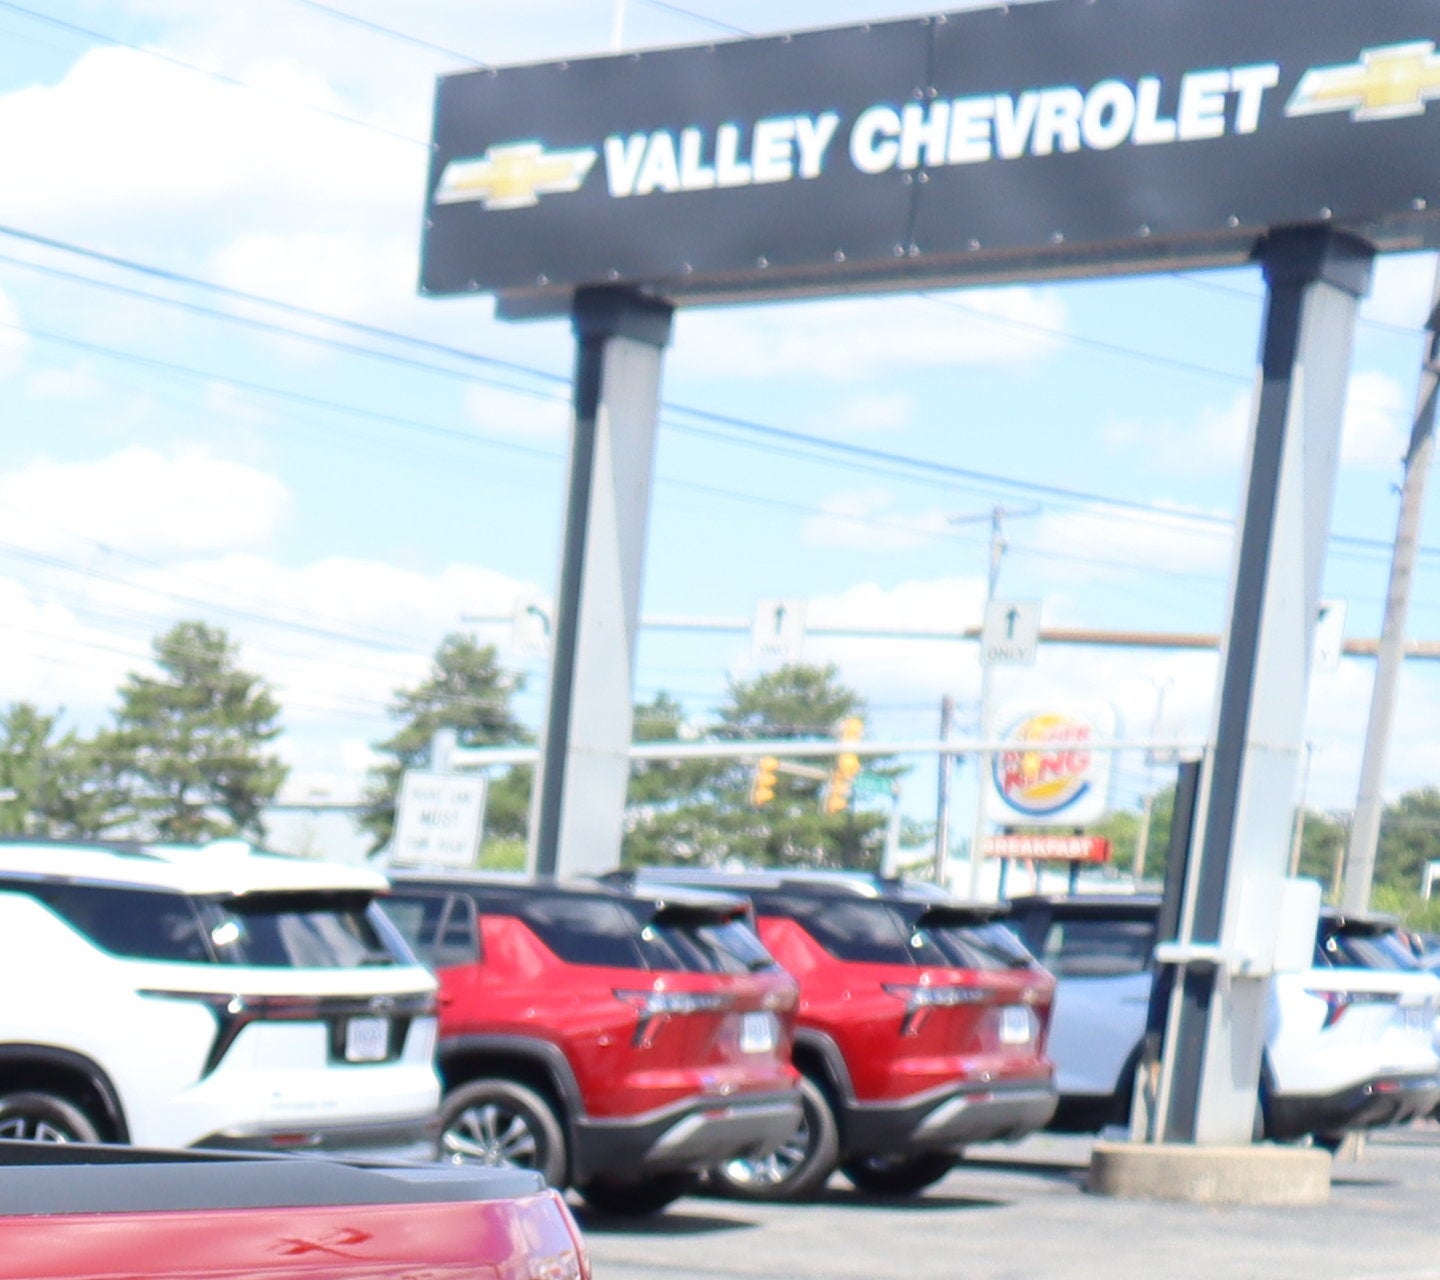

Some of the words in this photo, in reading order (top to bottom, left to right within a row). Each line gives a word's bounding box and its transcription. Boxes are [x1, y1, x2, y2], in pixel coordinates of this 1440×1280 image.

[604, 112, 840, 198] VALLEY
[848, 63, 1280, 175] CHEVROLET
[988, 646, 1026, 661] ONLY
